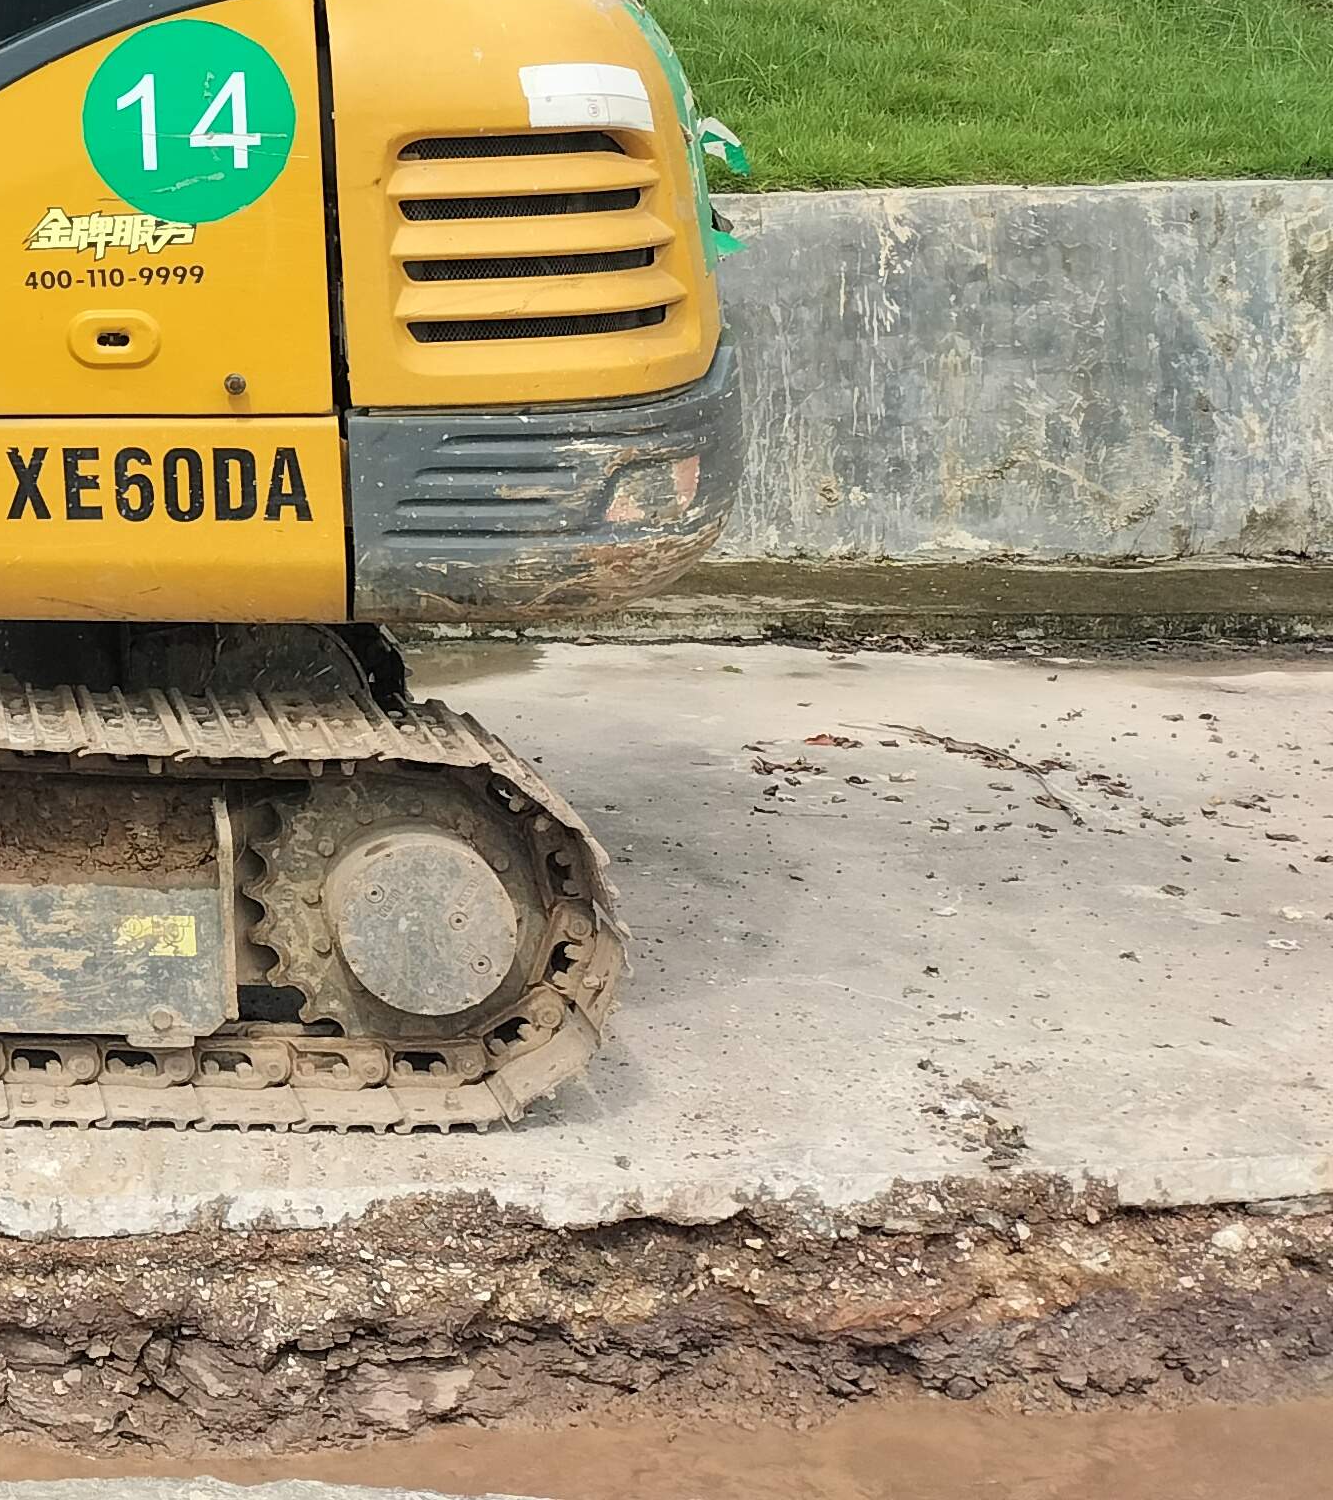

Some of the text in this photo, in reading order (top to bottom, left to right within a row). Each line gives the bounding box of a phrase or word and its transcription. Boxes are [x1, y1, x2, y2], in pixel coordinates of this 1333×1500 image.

[116, 71, 261, 171] 14
[25, 265, 205, 290] 400-110-9999
[6, 446, 314, 523] XE60DA
